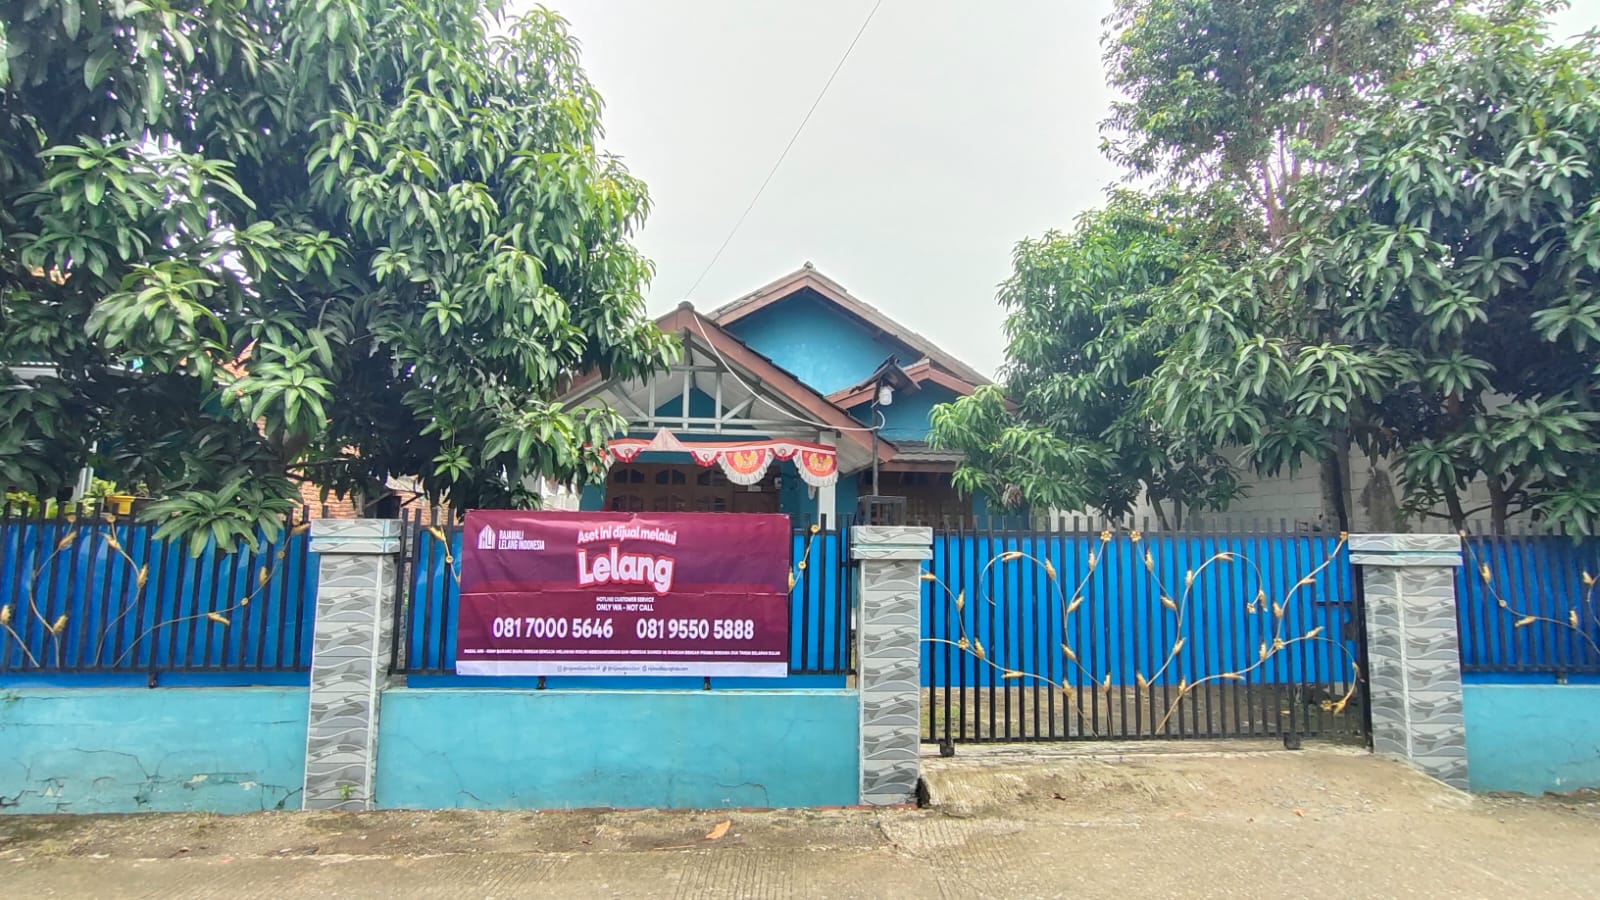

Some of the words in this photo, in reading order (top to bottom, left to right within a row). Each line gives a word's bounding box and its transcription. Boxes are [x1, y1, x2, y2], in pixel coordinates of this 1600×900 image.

[498, 539, 518, 550] LELANG
[518, 539, 545, 551] INDONESIA
[577, 527, 599, 544] Aset
[600, 525, 612, 540] ini
[612, 525, 640, 542] dijual
[640, 527, 677, 545] melalui
[577, 545, 674, 594] Lelang
[596, 603, 612, 611] ONLY
[612, 603, 622, 611] WA
[626, 603, 639, 611] NOT
[638, 603, 654, 611] CALL
[493, 617, 521, 638] 081
[525, 617, 568, 638] 7000
[572, 617, 614, 639] 5646
[636, 617, 665, 639] 081
[668, 618, 709, 639] 9550
[713, 619, 754, 640] 5888
